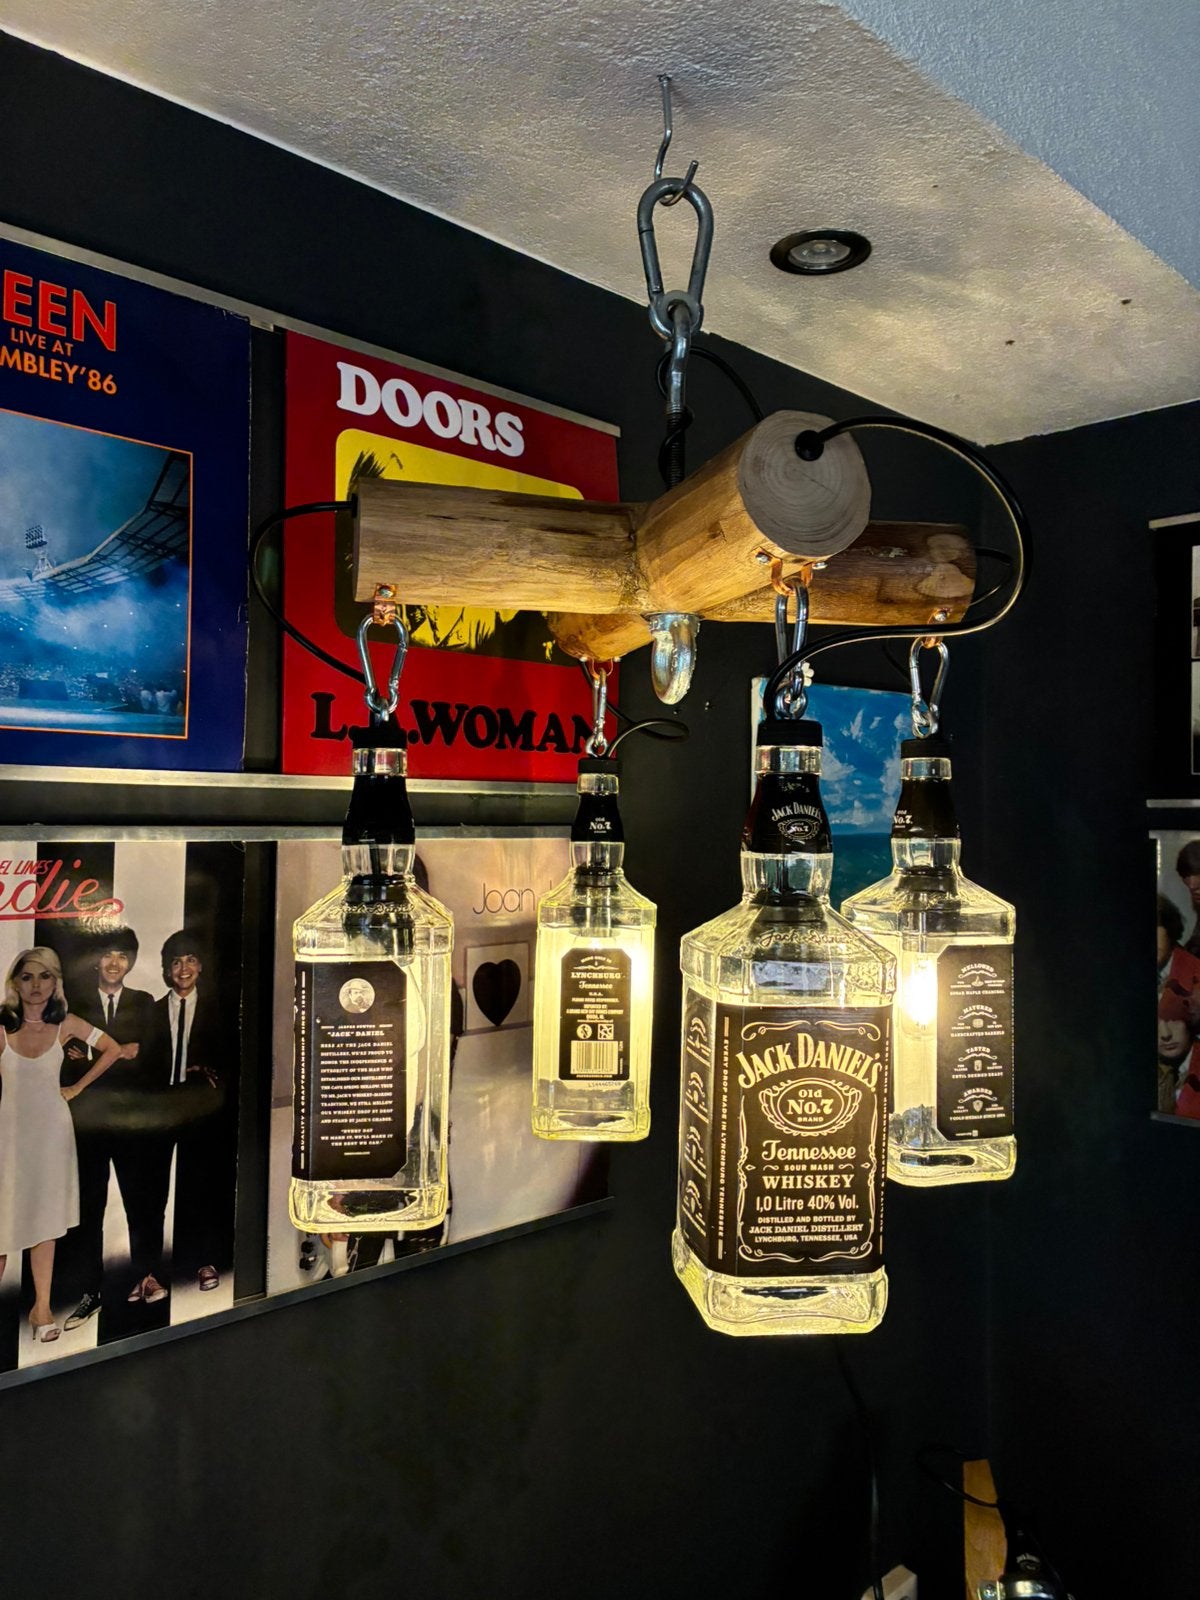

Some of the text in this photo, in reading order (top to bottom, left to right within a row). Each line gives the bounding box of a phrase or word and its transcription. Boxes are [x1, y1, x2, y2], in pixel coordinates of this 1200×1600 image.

[3, 269, 117, 352] EEN
[10, 327, 74, 357] LIVE AT
[336, 361, 525, 457] DOORS
[13, 859, 54, 875] LINES
[472, 882, 537, 915] Joan
[327, 1030, 355, 1038] "JACK"
[735, 1032, 883, 1090] JACK DANIEL'S
[798, 1089, 823, 1098] Old
[786, 1098, 835, 1115] No.7
[720, 1121, 727, 1131] IN
[761, 1139, 857, 1161] Tennessee
[762, 1174, 855, 1190] WHISKEY
[775, 1195, 804, 1211] Litre
[807, 1194, 835, 1210] 40%
[838, 1194, 859, 1209] Vol.
[749, 1223, 864, 1234] JACK DANIEL DISTILLERY
